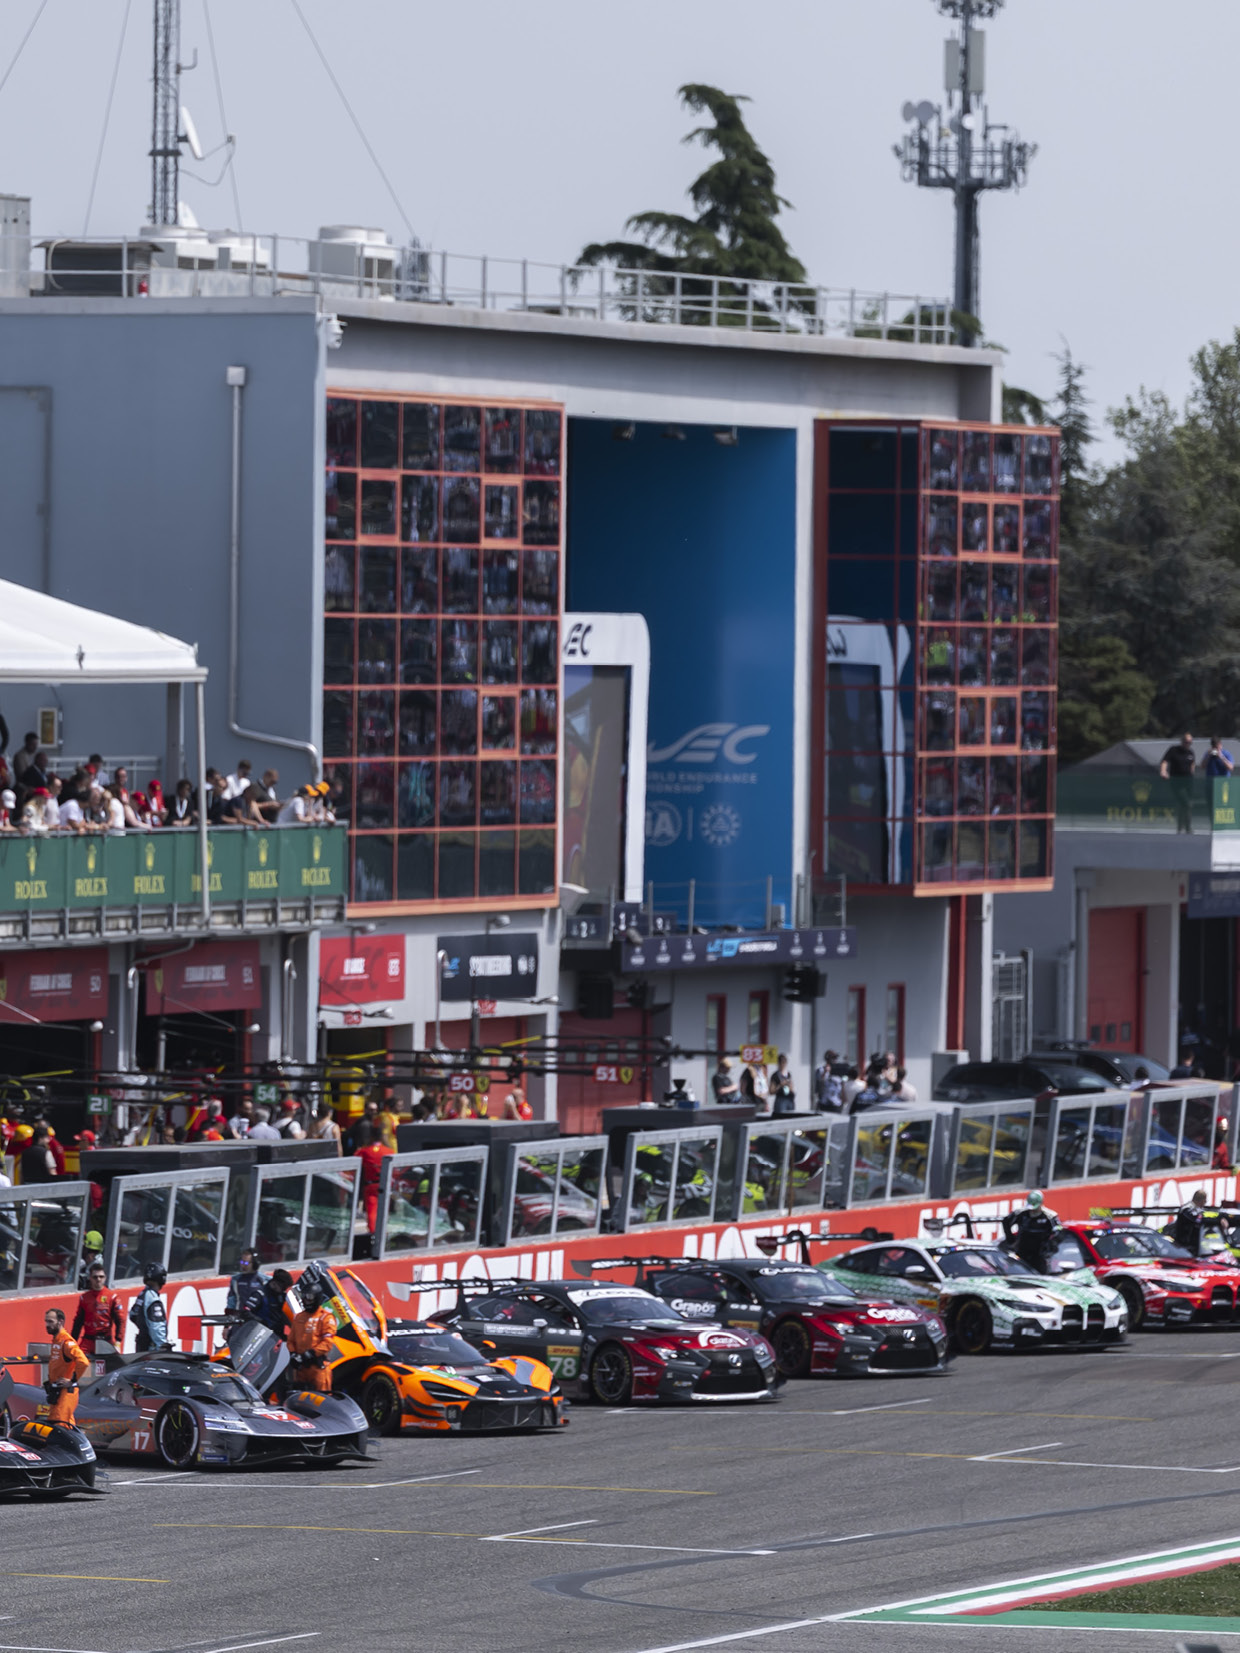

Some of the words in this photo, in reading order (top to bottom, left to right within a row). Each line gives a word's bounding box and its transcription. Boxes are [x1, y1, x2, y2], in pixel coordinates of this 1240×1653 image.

[595, 1066, 618, 1082] 51
[450, 1075, 475, 1091] 50
[257, 1086, 277, 1102] 54
[89, 1096, 109, 1112] 21
[550, 1357, 577, 1377] 78
[134, 1431, 150, 1450] 17
